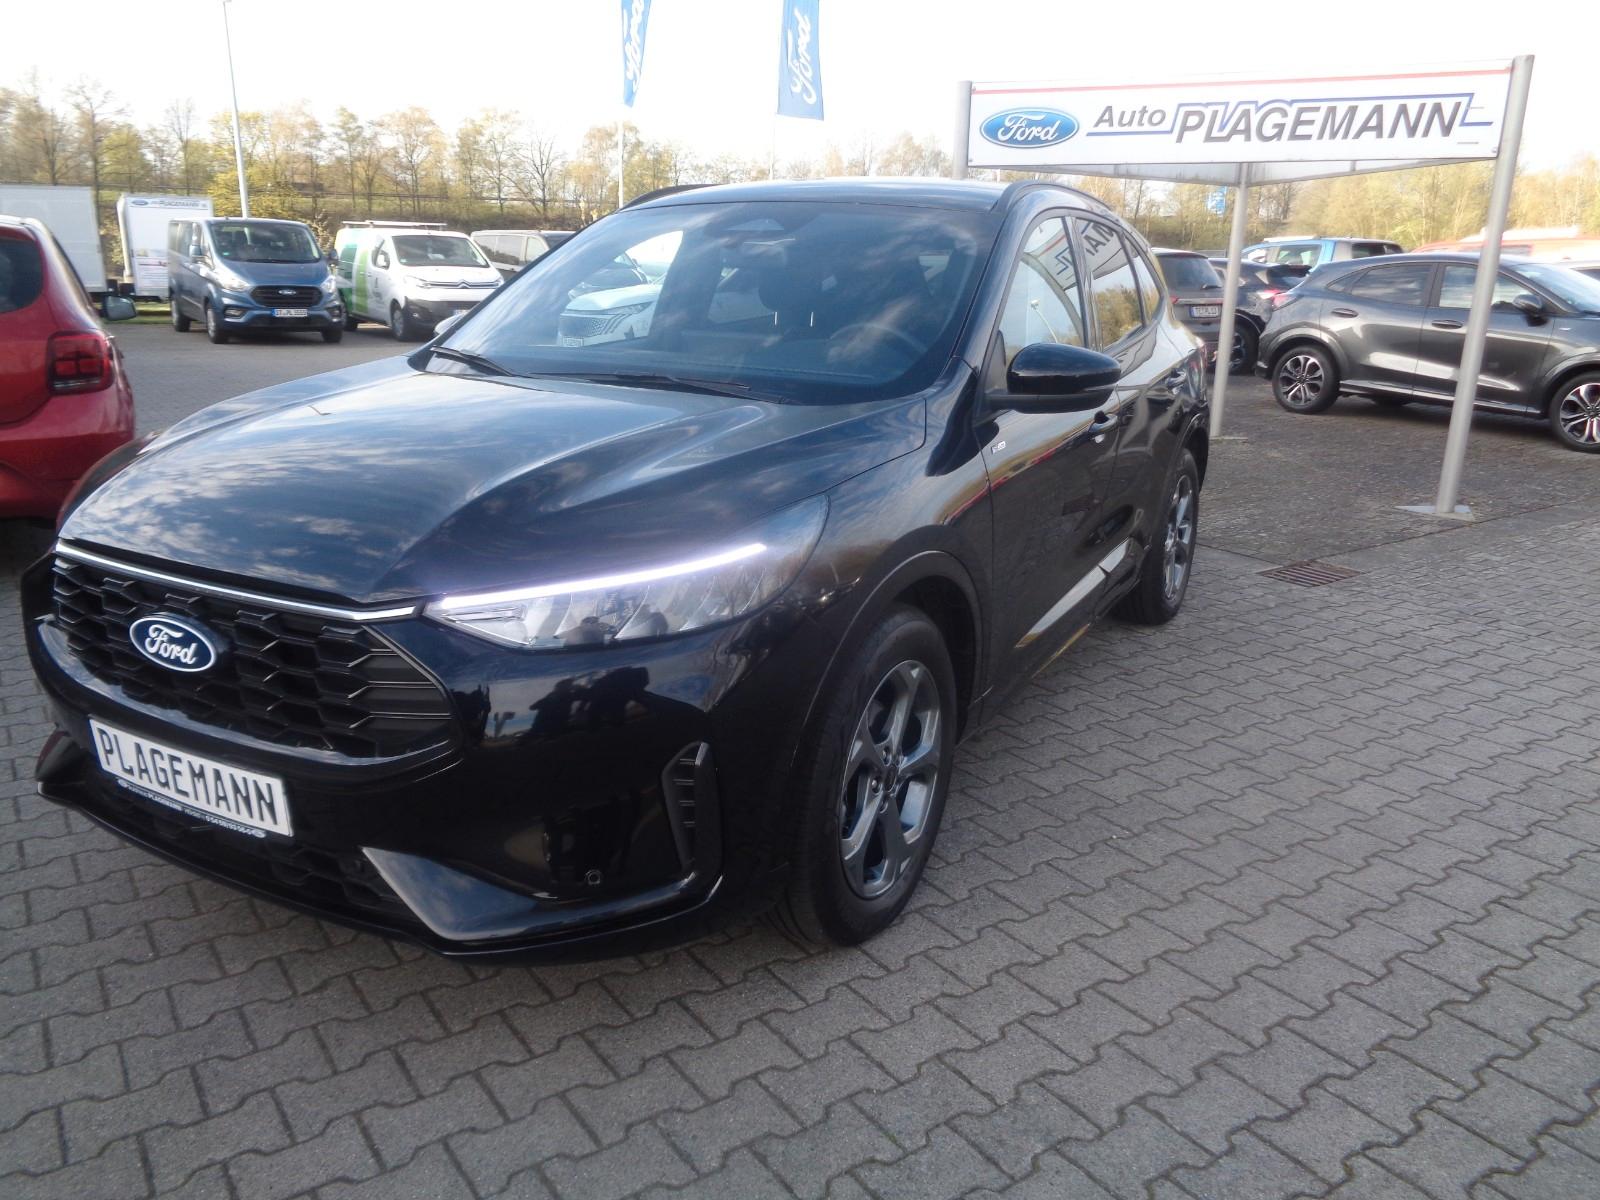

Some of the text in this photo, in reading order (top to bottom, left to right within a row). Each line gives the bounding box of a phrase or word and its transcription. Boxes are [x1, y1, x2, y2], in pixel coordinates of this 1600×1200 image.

[787, 7, 817, 105] Ford
[997, 112, 1061, 142] Ford
[1093, 101, 1462, 144] Auto PLAGEMANN
[144, 624, 198, 665] Ford
[96, 727, 279, 826] PLAGEMANN
